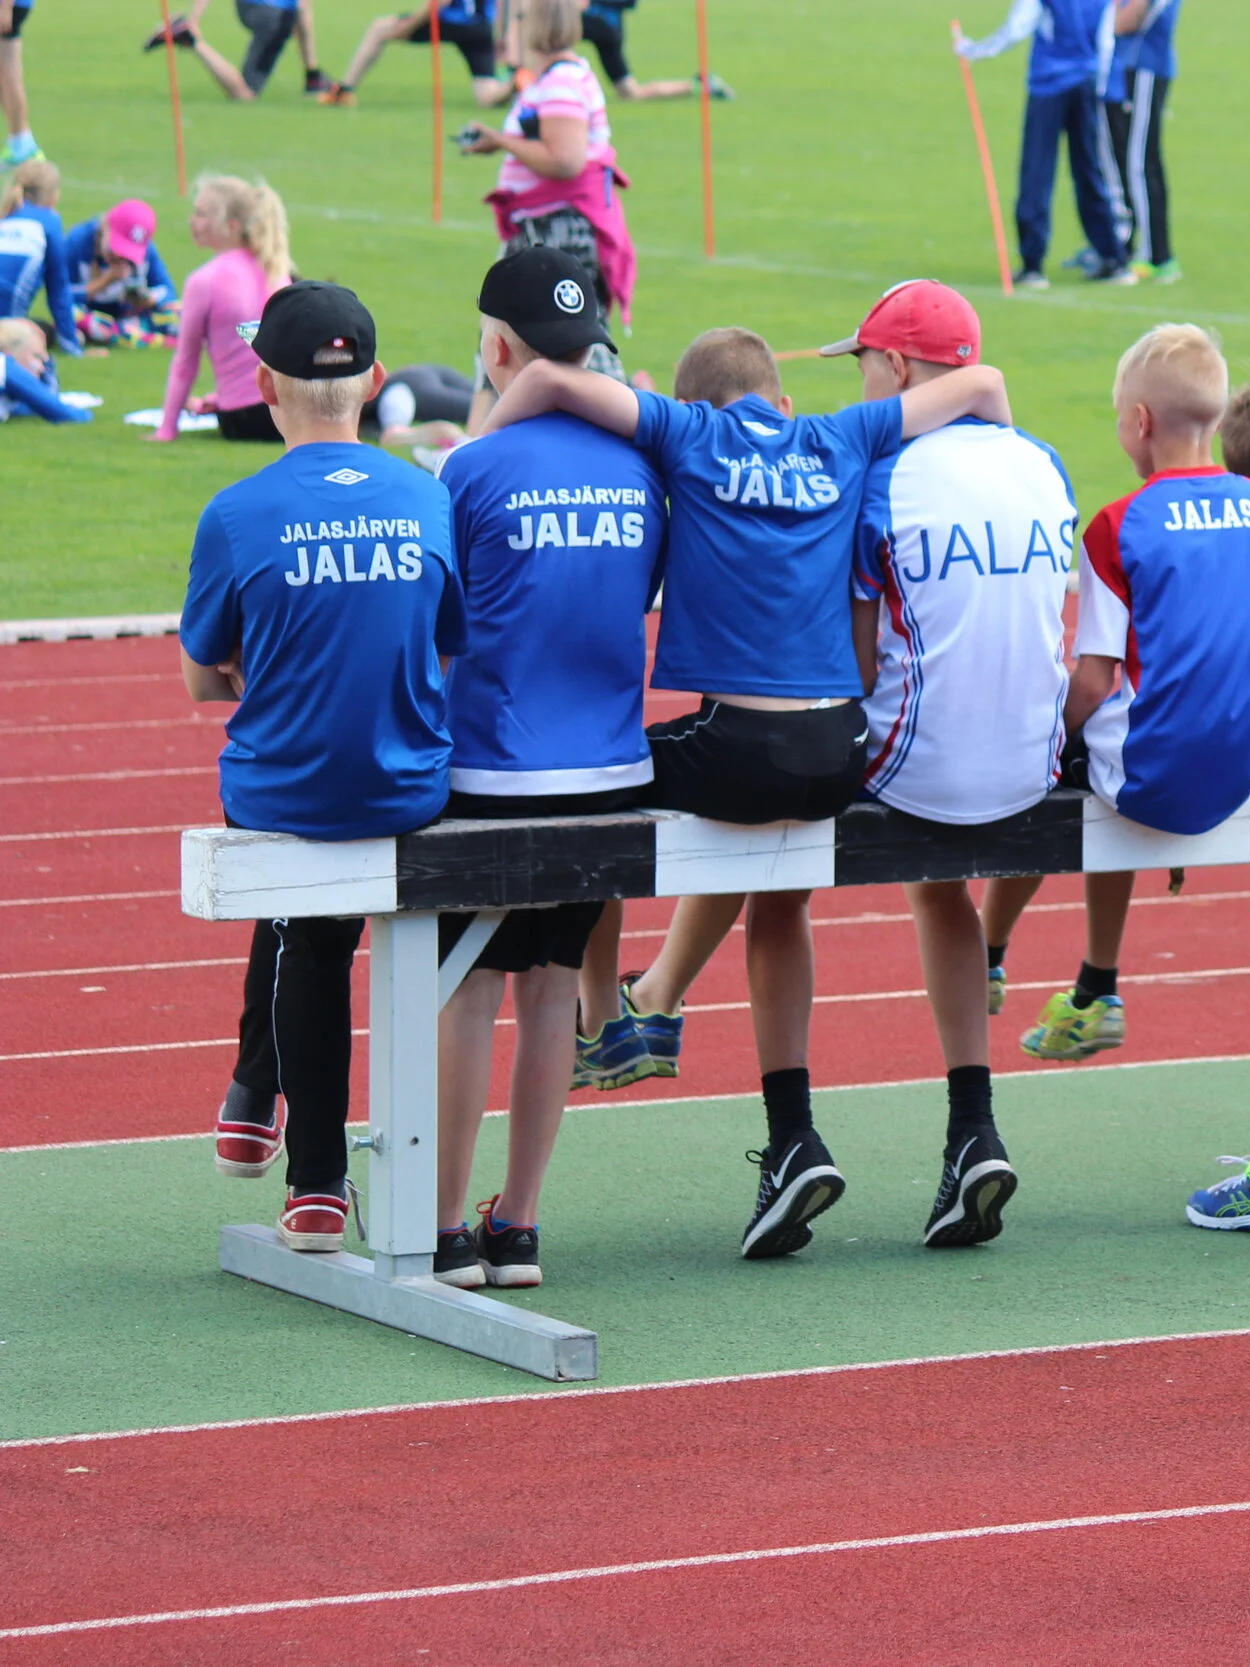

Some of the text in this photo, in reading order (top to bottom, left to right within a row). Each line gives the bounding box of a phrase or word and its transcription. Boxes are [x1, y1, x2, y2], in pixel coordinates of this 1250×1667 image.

[505, 486, 646, 511] JALASJÄRVEN
[715, 467, 840, 507] JALAS
[280, 516, 420, 544] JALASJÄRVEN
[508, 511, 645, 551] JALAS
[285, 542, 423, 587] JALAS
